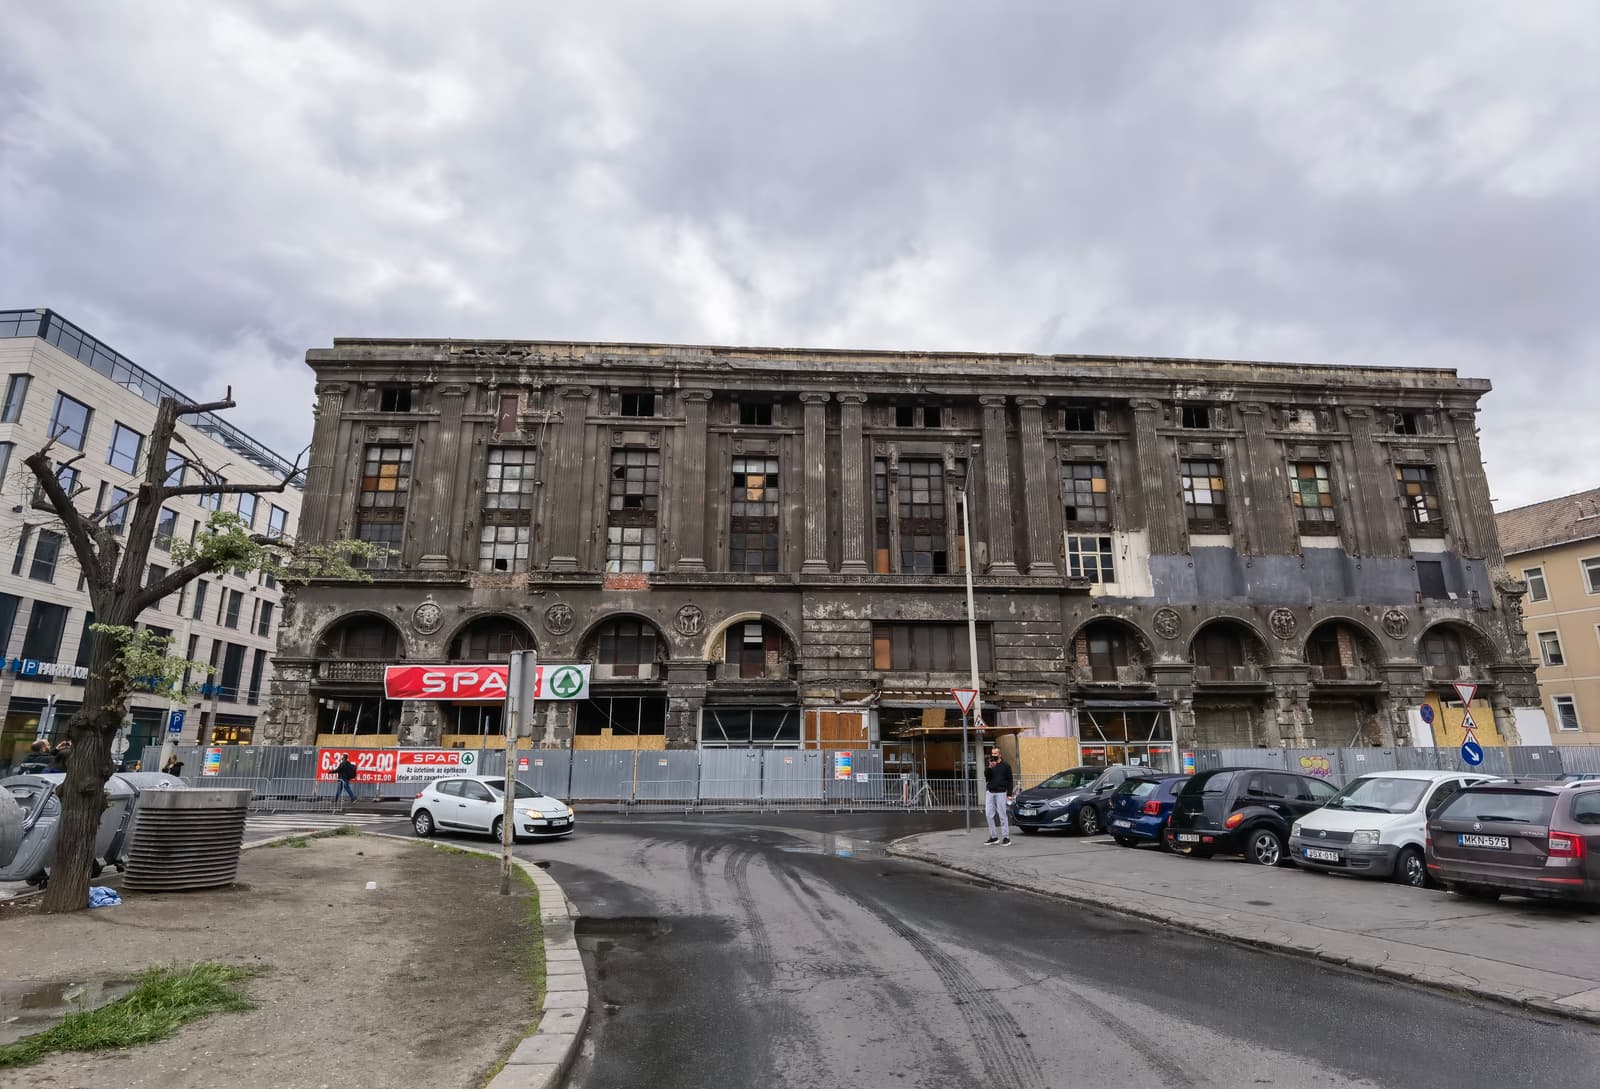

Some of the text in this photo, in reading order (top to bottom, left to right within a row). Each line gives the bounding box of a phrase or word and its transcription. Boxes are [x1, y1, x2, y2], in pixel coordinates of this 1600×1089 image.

[26, 662, 36, 673] P
[174, 715, 181, 726] P
[413, 754, 458, 763] SPAR
[1463, 833, 1507, 848] MKN-575
